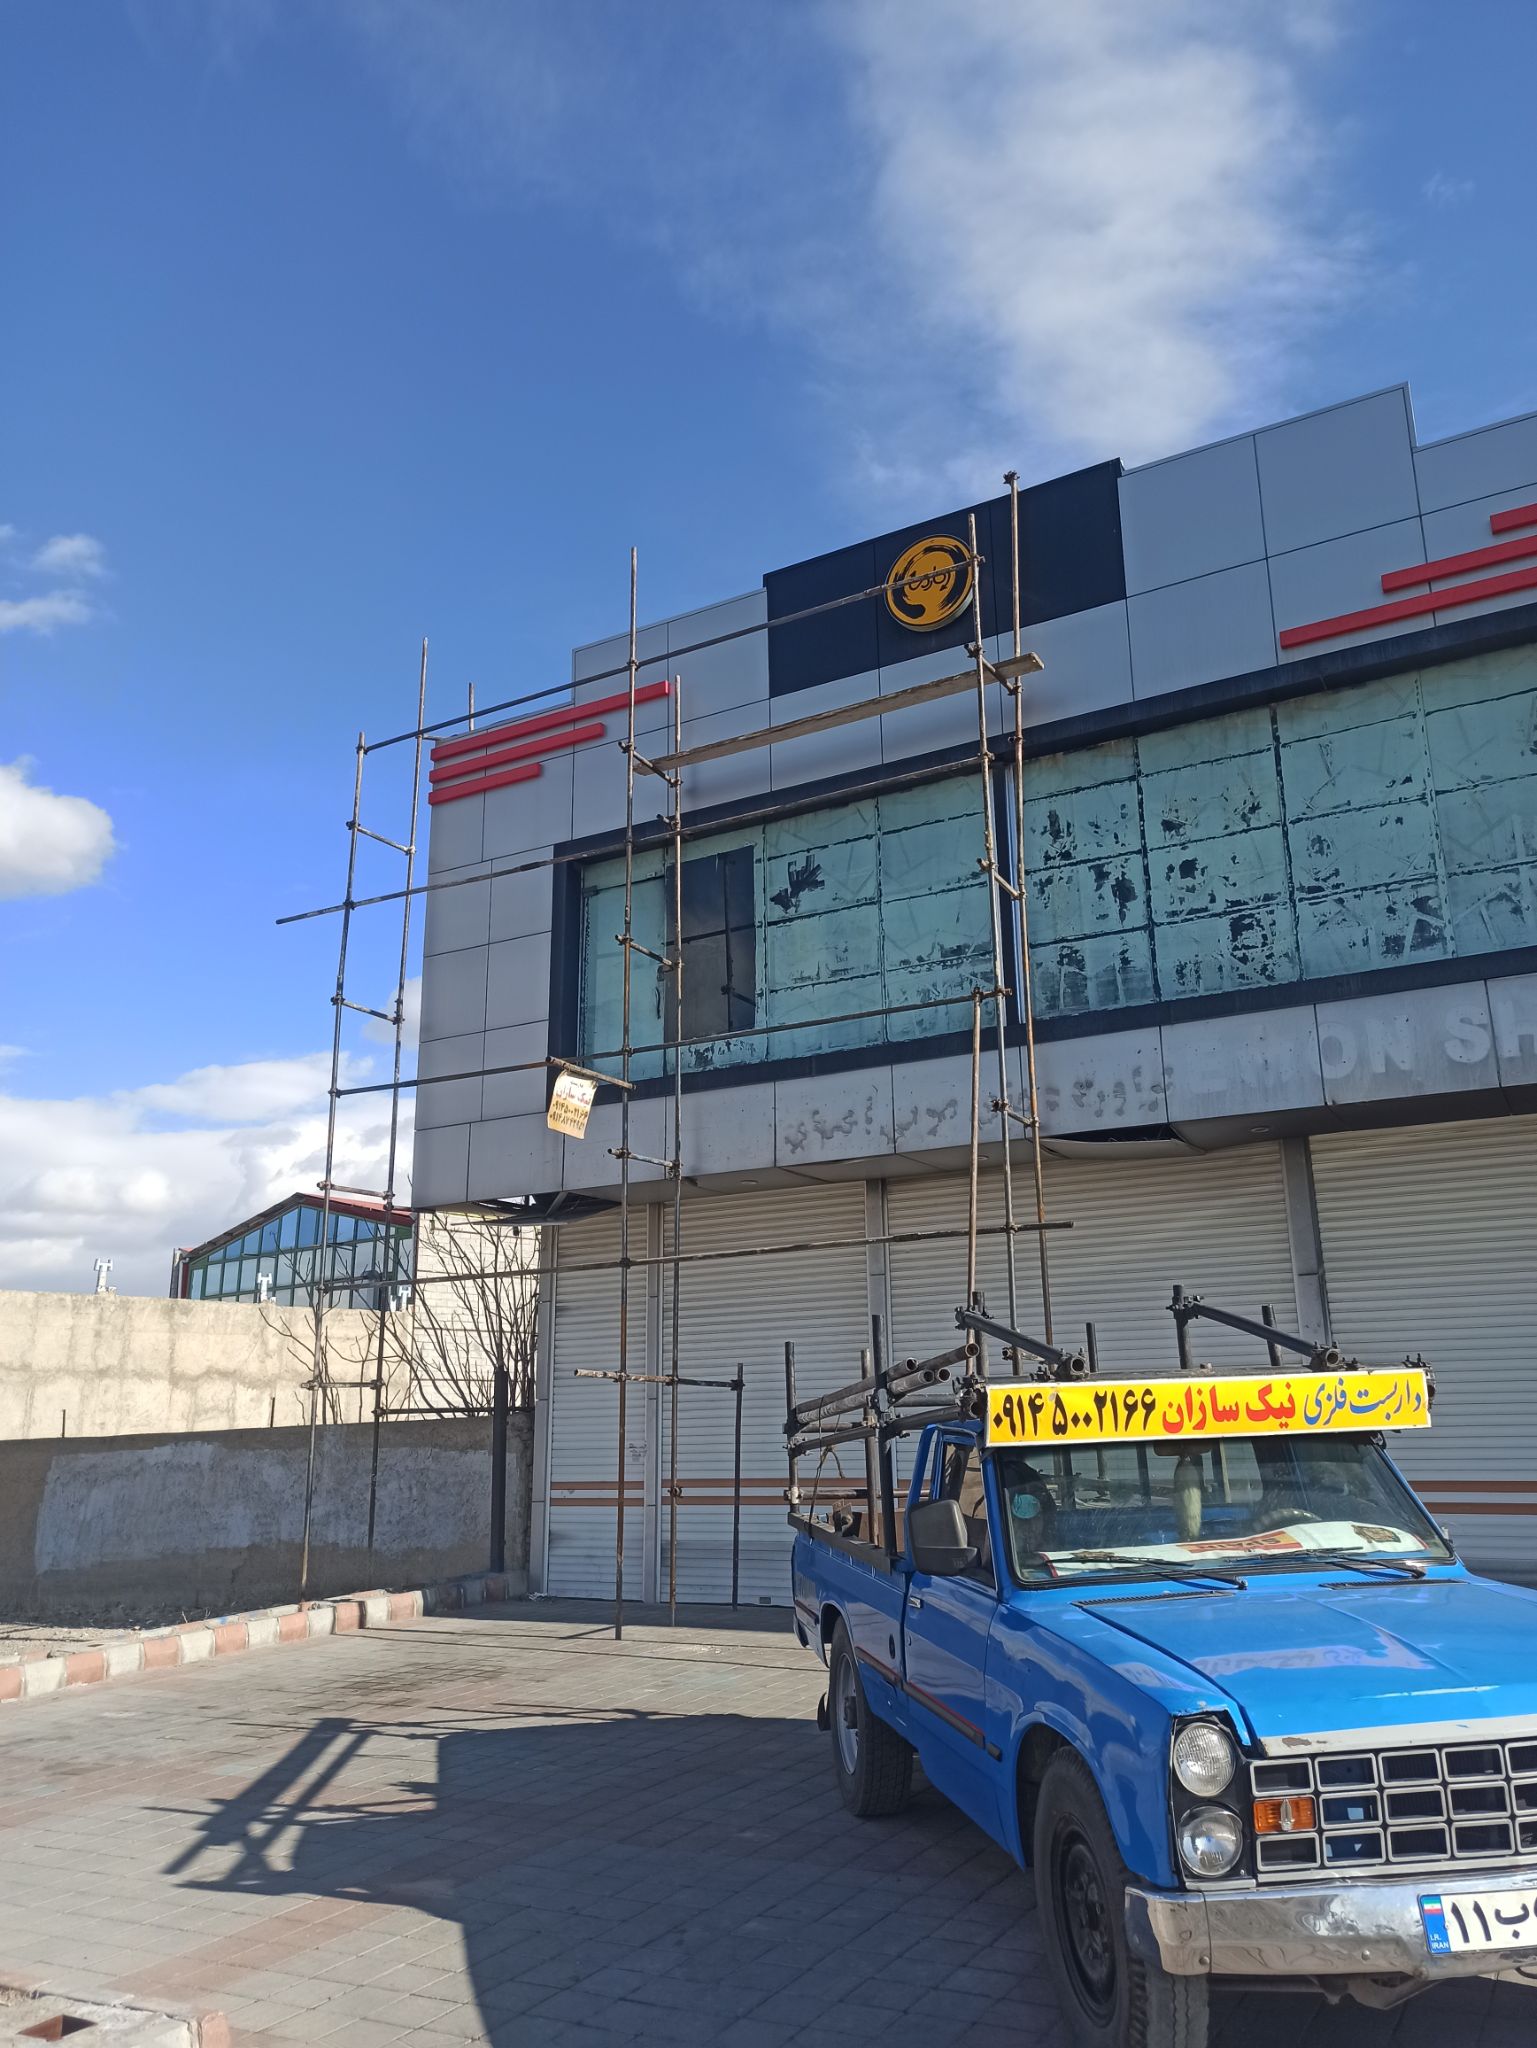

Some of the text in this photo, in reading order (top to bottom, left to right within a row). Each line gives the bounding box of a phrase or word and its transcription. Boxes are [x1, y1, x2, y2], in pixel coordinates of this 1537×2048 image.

[1162, 1385, 1240, 1434] سازان
[1245, 1381, 1296, 1429] نیک
[1303, 1378, 1347, 1427] فلزی
[1349, 1379, 1421, 1421] داربست
[1431, 1941, 1449, 1950] IRAN
